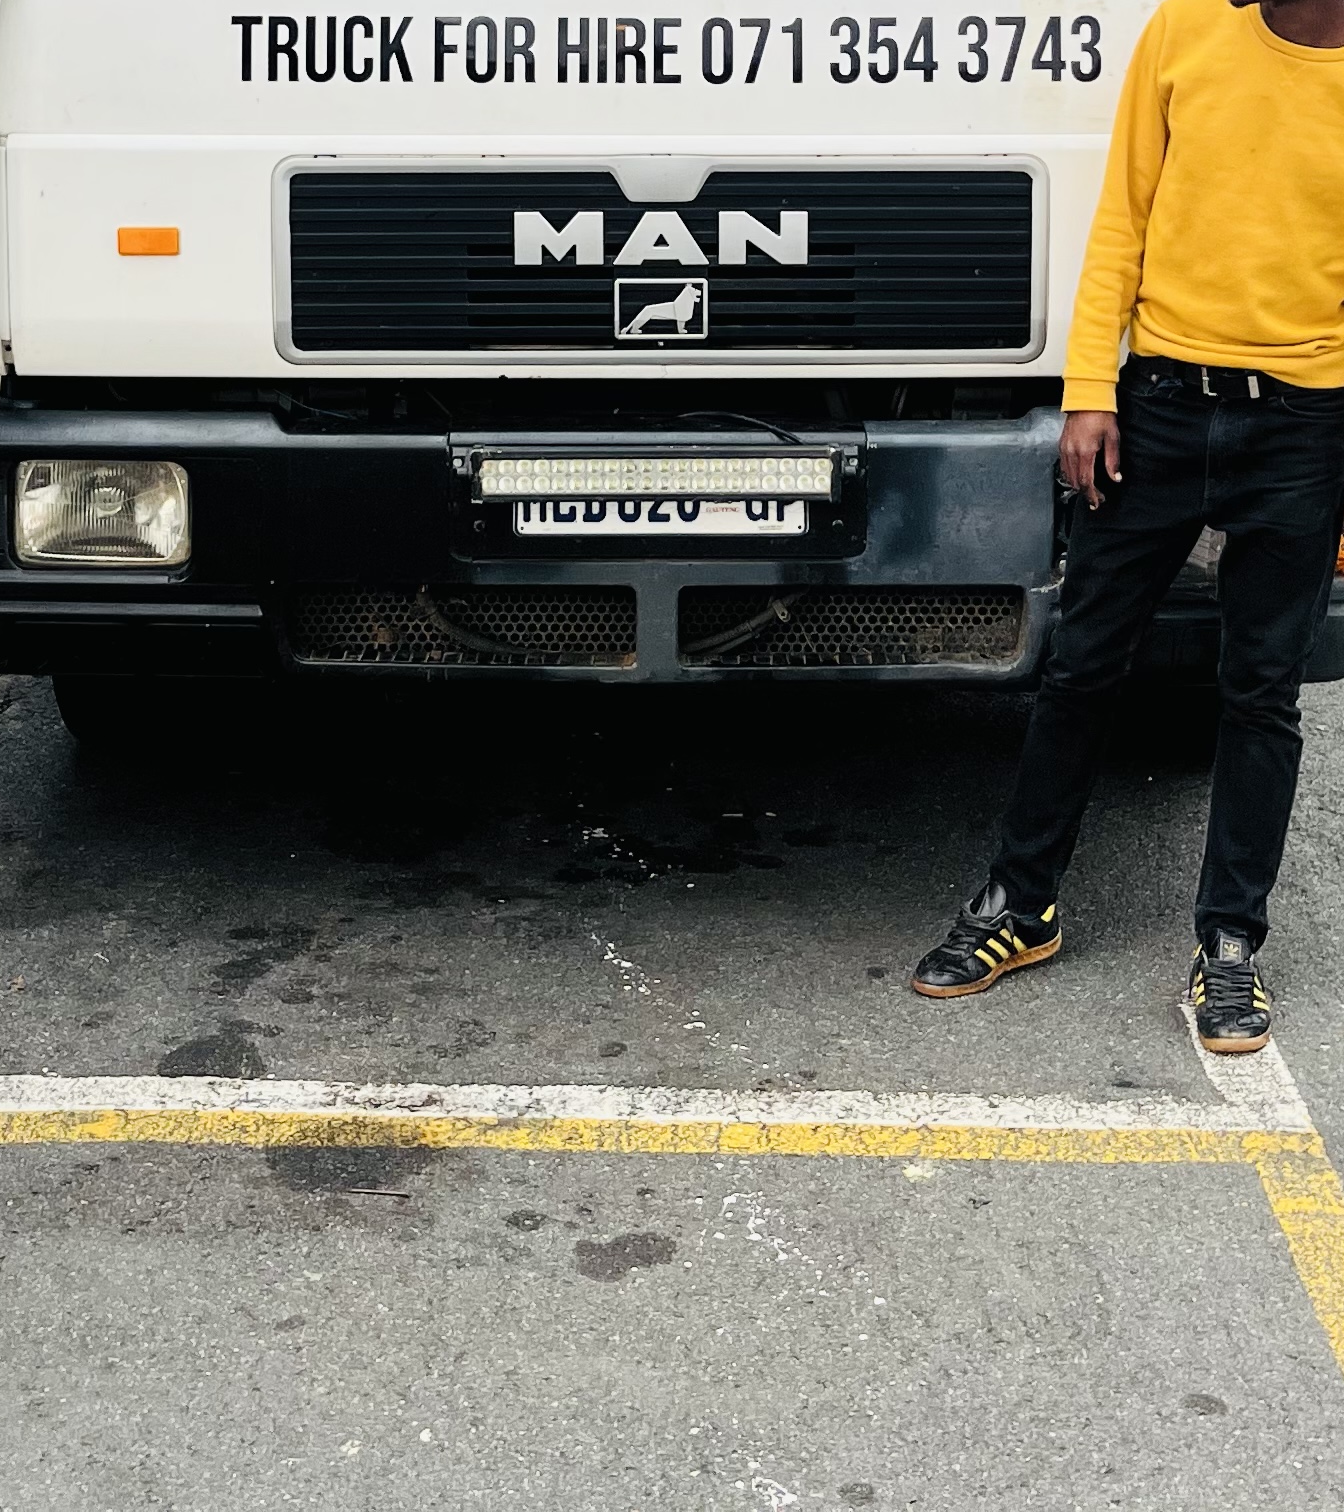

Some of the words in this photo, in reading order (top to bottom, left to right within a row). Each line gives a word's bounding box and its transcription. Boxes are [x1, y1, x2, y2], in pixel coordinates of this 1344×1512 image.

[231, 15, 413, 82] TRUCK
[434, 15, 536, 83] FOR
[557, 17, 682, 84] HIRE
[701, 17, 803, 85] 071
[829, 16, 938, 84] 354
[957, 15, 1102, 83] 3743
[513, 211, 809, 266] MAN
